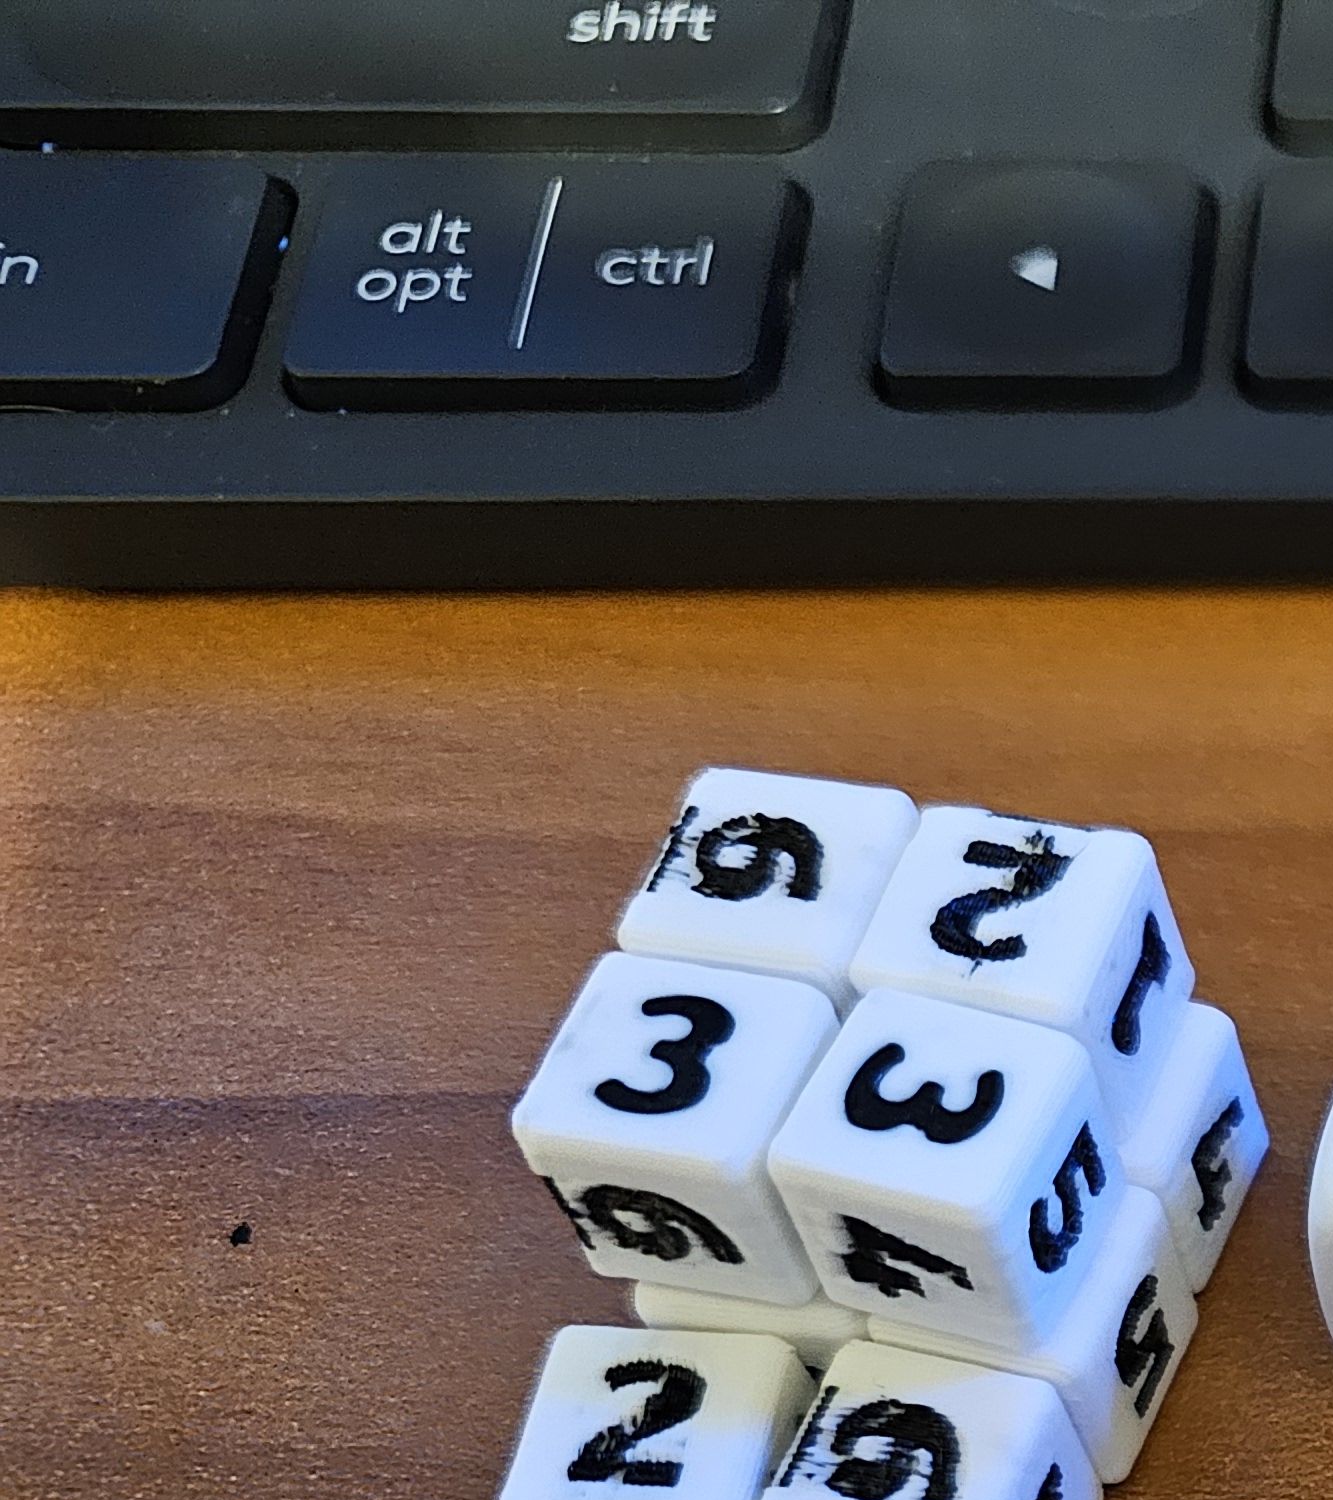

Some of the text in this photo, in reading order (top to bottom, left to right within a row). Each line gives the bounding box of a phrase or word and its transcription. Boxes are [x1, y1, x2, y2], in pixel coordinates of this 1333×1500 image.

[566, 0, 717, 43] shift
[0, 242, 39, 285] n
[379, 209, 471, 255] alt
[597, 238, 715, 288] ctrl
[356, 262, 473, 313] opt
[930, 836, 1076, 961] 2
[594, 995, 736, 1114] 3
[844, 1043, 1004, 1145] 3
[1029, 1120, 1107, 1273] 5
[567, 1357, 707, 1488] 2
